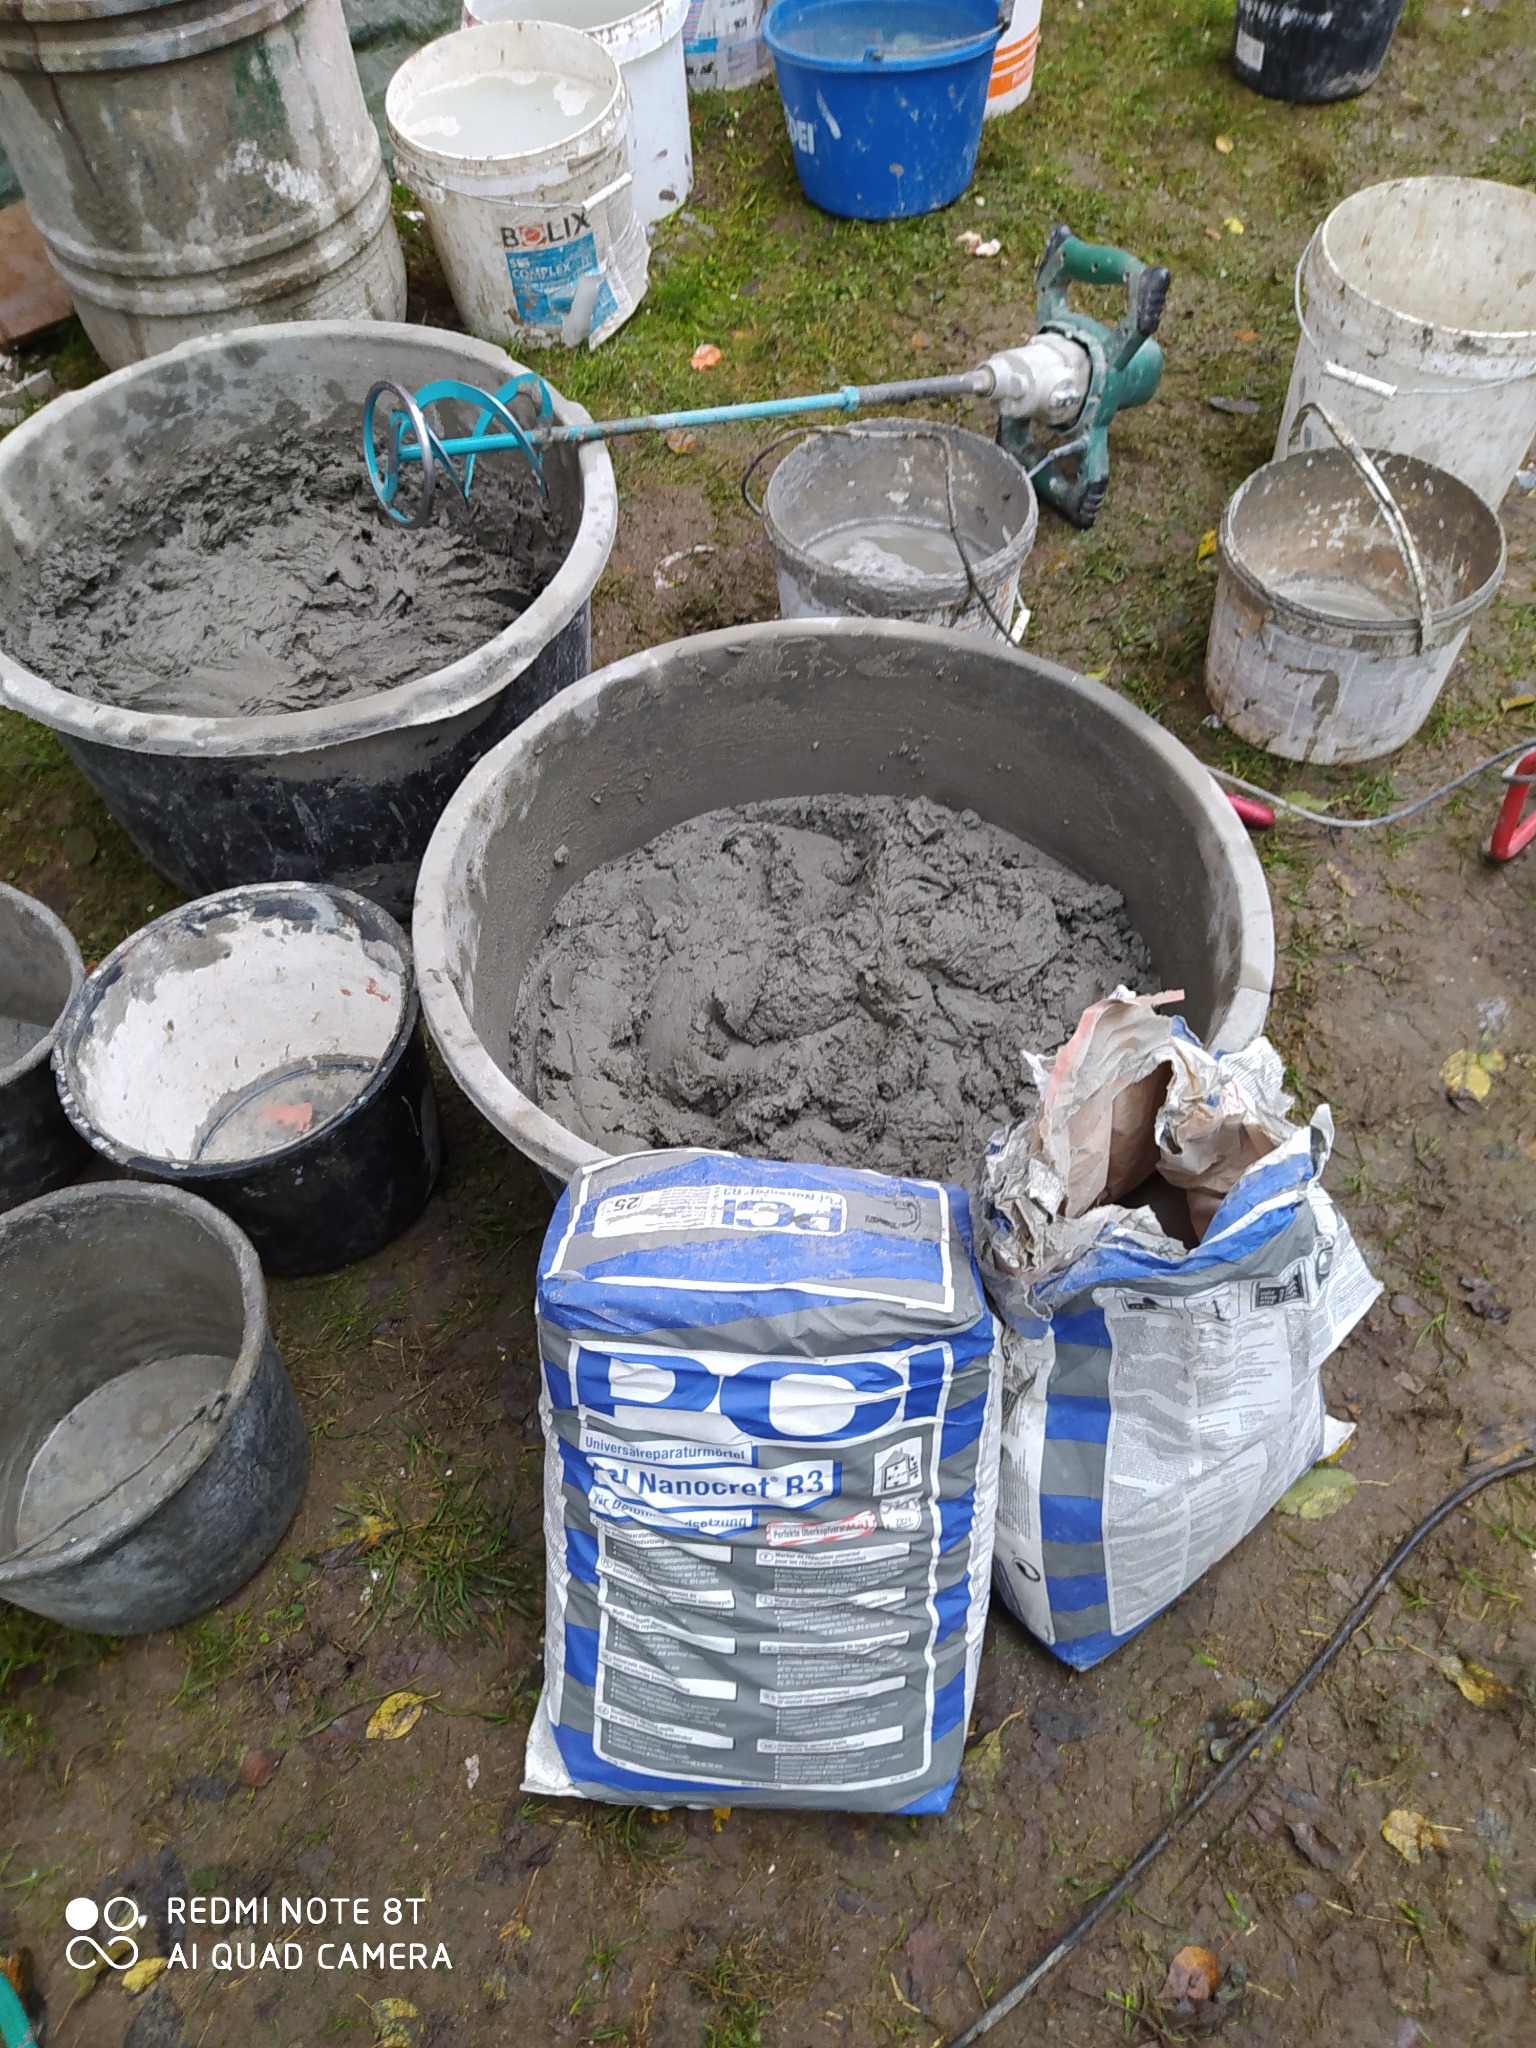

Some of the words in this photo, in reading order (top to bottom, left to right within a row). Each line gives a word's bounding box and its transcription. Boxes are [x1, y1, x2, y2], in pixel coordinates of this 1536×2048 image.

[500, 212, 591, 248] BOLIX
[614, 1197, 641, 1212] 25
[721, 1198, 843, 1232] PCI
[578, 1346, 947, 1442] PCI
[585, 1436, 745, 1461] Universalreparaturmörtel
[785, 1470, 824, 1498] R3
